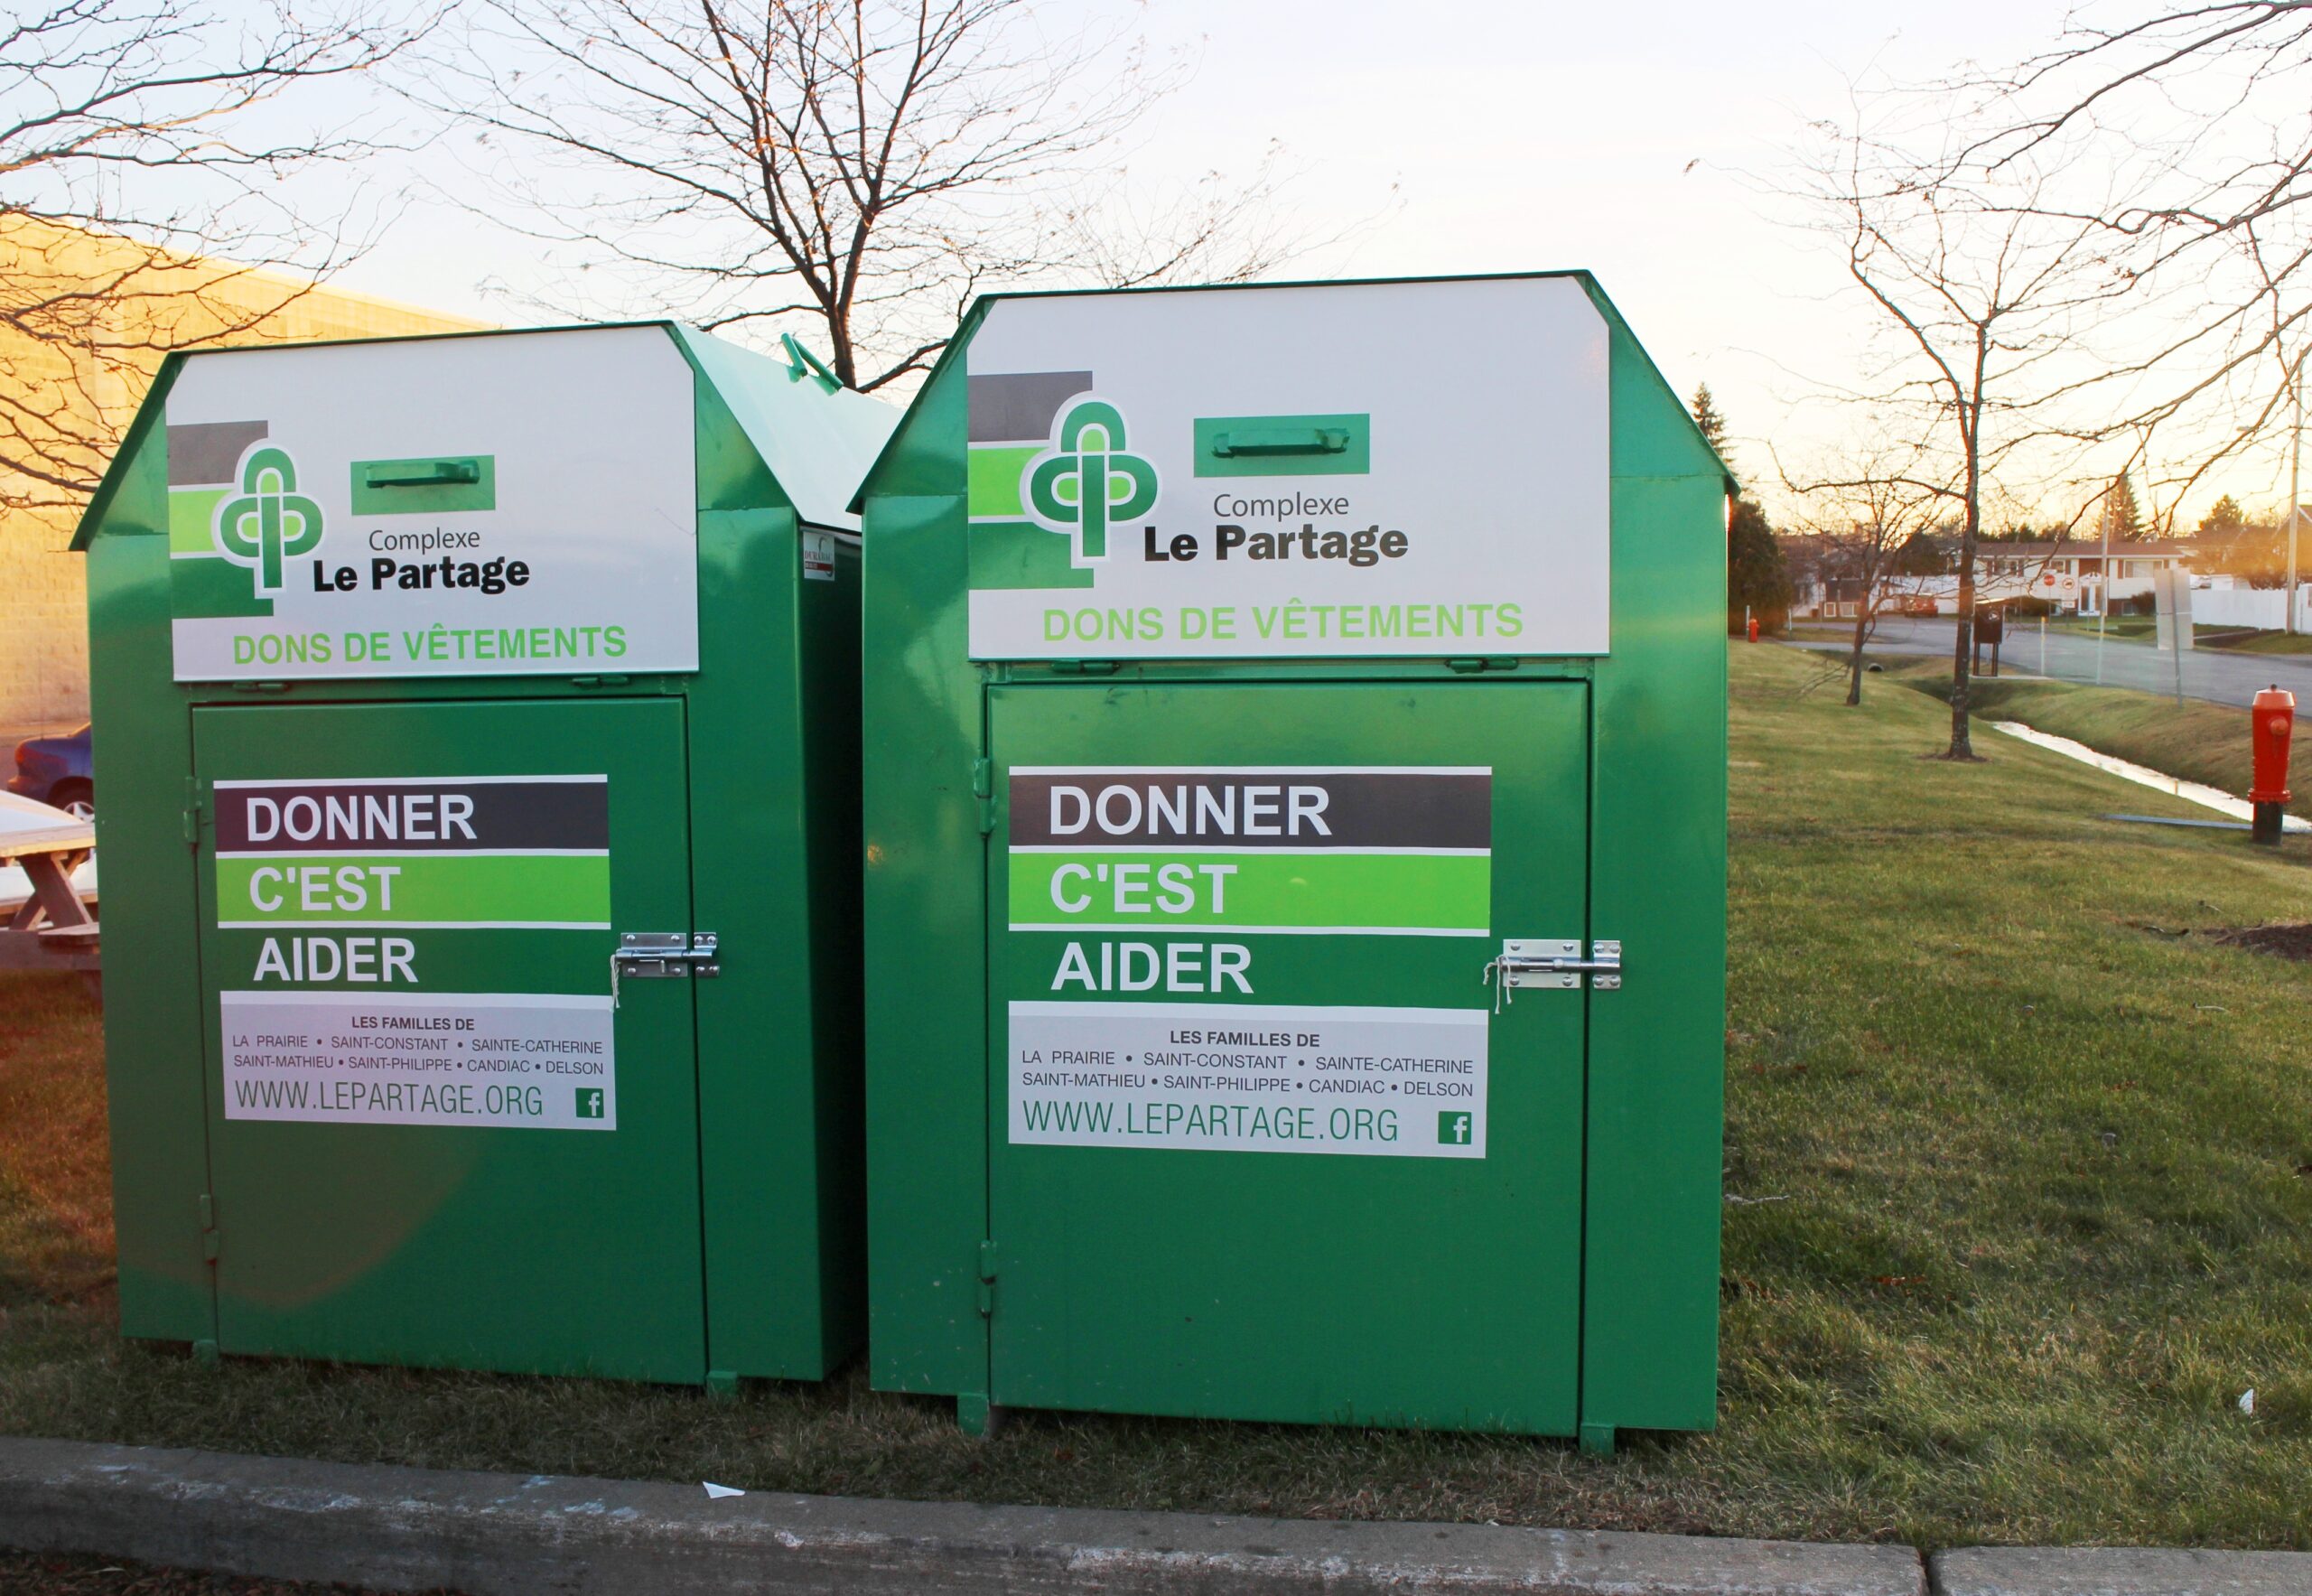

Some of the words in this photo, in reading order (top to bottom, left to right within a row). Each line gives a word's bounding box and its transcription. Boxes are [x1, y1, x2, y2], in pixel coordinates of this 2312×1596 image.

[1213, 491, 1349, 522] Complexe
[368, 527, 480, 555] Complexe
[1144, 525, 1198, 562] Le
[1216, 523, 1409, 567] Partage
[312, 559, 359, 593] Le
[371, 556, 530, 595] Partage
[1043, 607, 1165, 642] DONS
[1180, 606, 1236, 640] DE
[1251, 597, 1524, 639] VÊTEMENTS
[233, 632, 332, 665] DONS
[344, 631, 391, 663] DE
[404, 623, 628, 662] VÊTEMENTS
[246, 794, 478, 842] DONNER
[1049, 784, 1332, 836] DONNER
[249, 865, 401, 912] C'EST
[1049, 863, 1238, 914] C'EST
[253, 937, 419, 983] AIDER
[1050, 941, 1254, 994] AIDER
[351, 1016, 378, 1029] LES
[382, 1017, 452, 1030] FAMILLES
[455, 1018, 475, 1031] DE
[1170, 1030, 1202, 1044] LES
[1207, 1031, 1291, 1047] FAMILLES
[1297, 1034, 1320, 1048] DE
[232, 1035, 249, 1048] LA
[256, 1035, 308, 1048] PRAIRIE
[331, 1036, 449, 1050] SAINT-CONSTANT
[471, 1039, 602, 1054] SAINTE-CATHERINE
[1021, 1050, 1042, 1064] LA
[1052, 1050, 1115, 1065] PRAIRIE
[1143, 1052, 1287, 1069] SAINT-CONSTANT
[1315, 1057, 1473, 1074] SAINTE-CATHERINE
[234, 1055, 334, 1069] SAINT-MATHIEU
[349, 1057, 452, 1071] SAINT-PHILIPPE
[467, 1059, 530, 1072] CANDIAC
[545, 1060, 603, 1075] DELSON
[1022, 1072, 1145, 1088] SAINT-MATHIEU
[1163, 1075, 1291, 1092] SAINT-PHILIPPE
[1309, 1079, 1385, 1094] CANDIAC
[1404, 1082, 1473, 1097] DELSON
[235, 1080, 543, 1115] WWW.LEPARTAGE.ORG
[1022, 1099, 1397, 1142] WWW.LEPARTAGE.ORG
